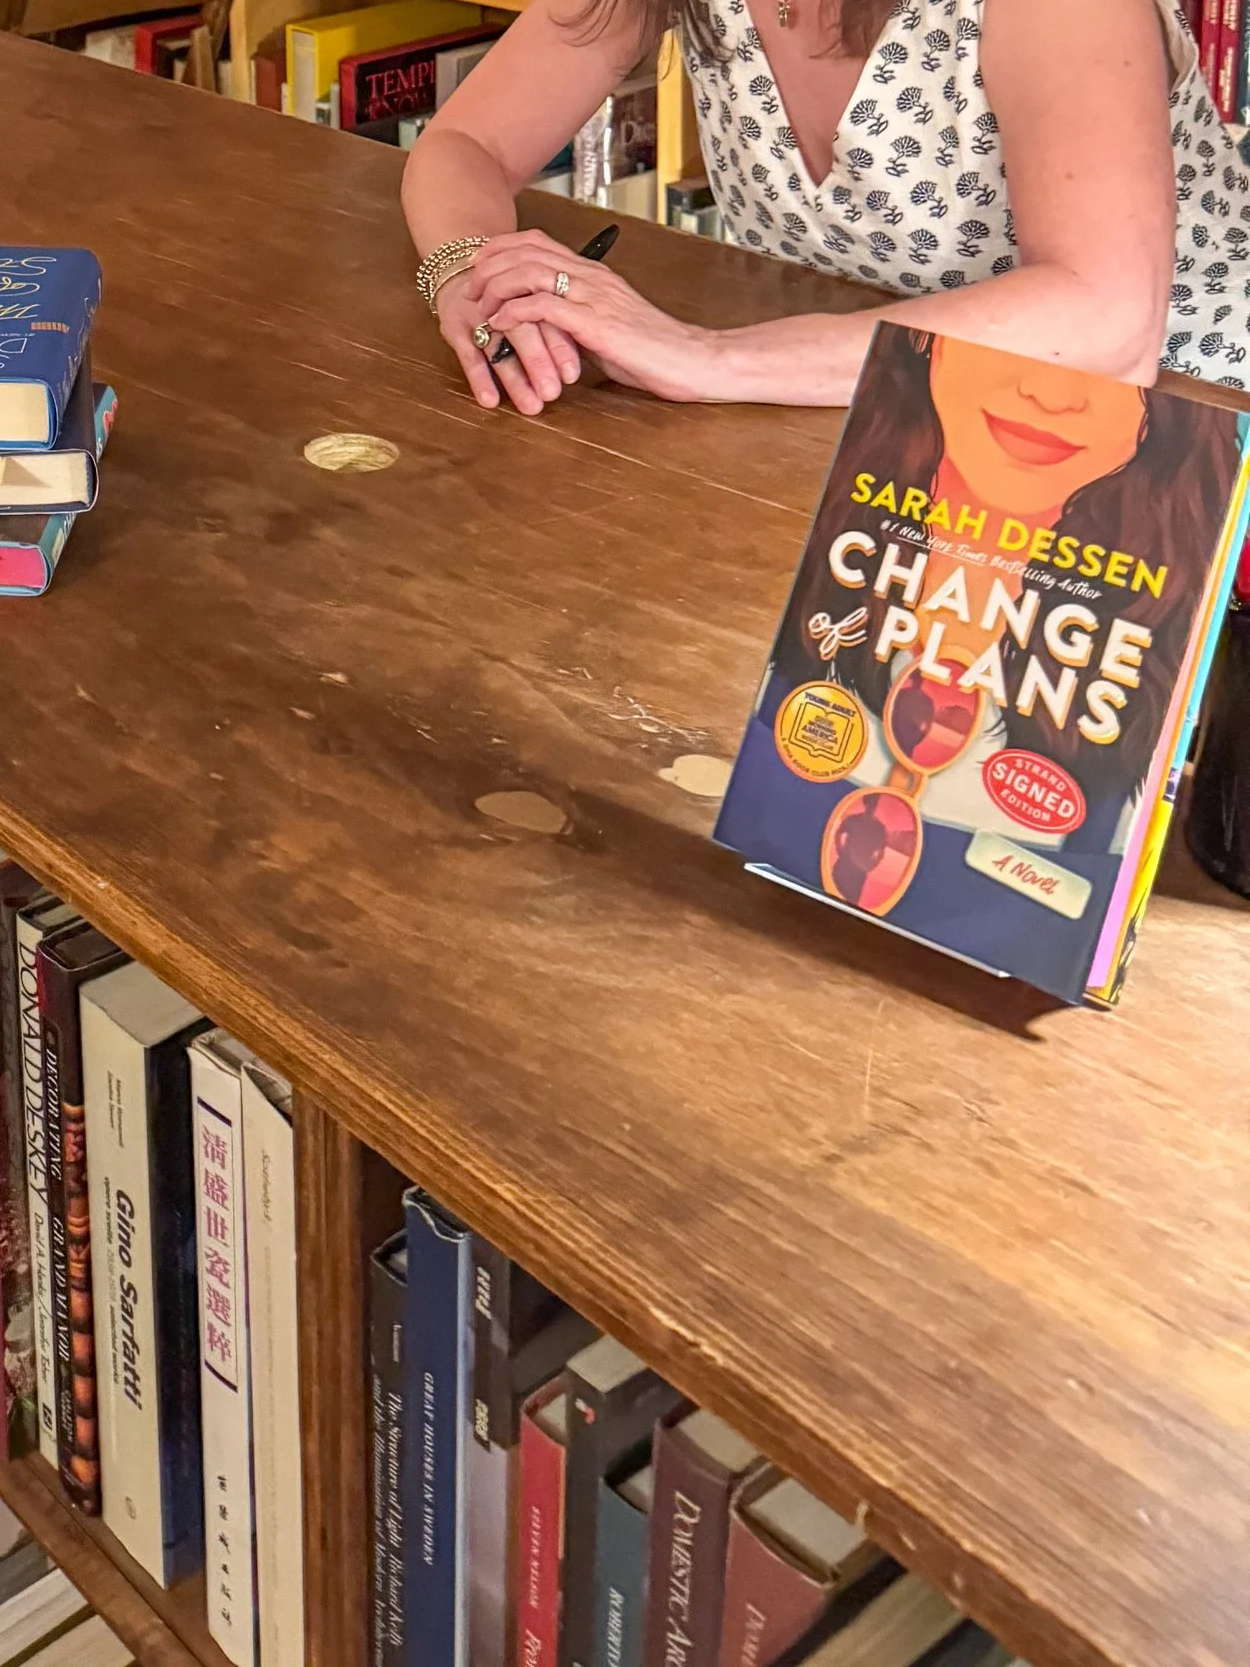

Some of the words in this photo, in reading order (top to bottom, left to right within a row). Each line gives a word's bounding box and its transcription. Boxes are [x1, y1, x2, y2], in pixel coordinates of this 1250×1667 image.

[850, 472, 989, 540] SARAH
[997, 519, 1169, 599] DESSEN
[899, 525, 924, 544] New
[926, 534, 954, 555] York
[955, 542, 989, 565] Times
[989, 555, 1057, 588] Bestselling
[1056, 576, 1103, 601] Author
[828, 531, 1152, 688] CHANGE
[808, 606, 868, 661] of
[875, 605, 1129, 745] PLANS
[801, 725, 839, 745] AMERICA
[992, 762, 1076, 819] SIGNED
[1000, 788, 1051, 823] EDITION
[1015, 758, 1068, 792] STRAND
[992, 854, 1014, 872] A
[1010, 862, 1061, 895] Novel
[19, 941, 46, 1084] DONALD
[46, 1047, 64, 1182] DECORATING
[23, 1087, 49, 1206] DESKEY
[52, 1215, 69, 1287] GRAND
[115, 1189, 135, 1269] Gino
[54, 1288, 73, 1363] MANOR
[116, 1286, 144, 1412] Sarfatti
[387, 1391, 402, 1417] The
[423, 1372, 435, 1420] GREAT
[387, 1421, 403, 1488] Structure
[422, 1423, 435, 1482] HOUSES
[387, 1491, 403, 1505] of
[422, 1485, 434, 1503] IN
[387, 1508, 404, 1548] Light
[421, 1505, 435, 1567] SWEDEN
[529, 1505, 542, 1554] STEVEN
[669, 1490, 701, 1623] DOMESTIC
[528, 1556, 541, 1610] NELSON
